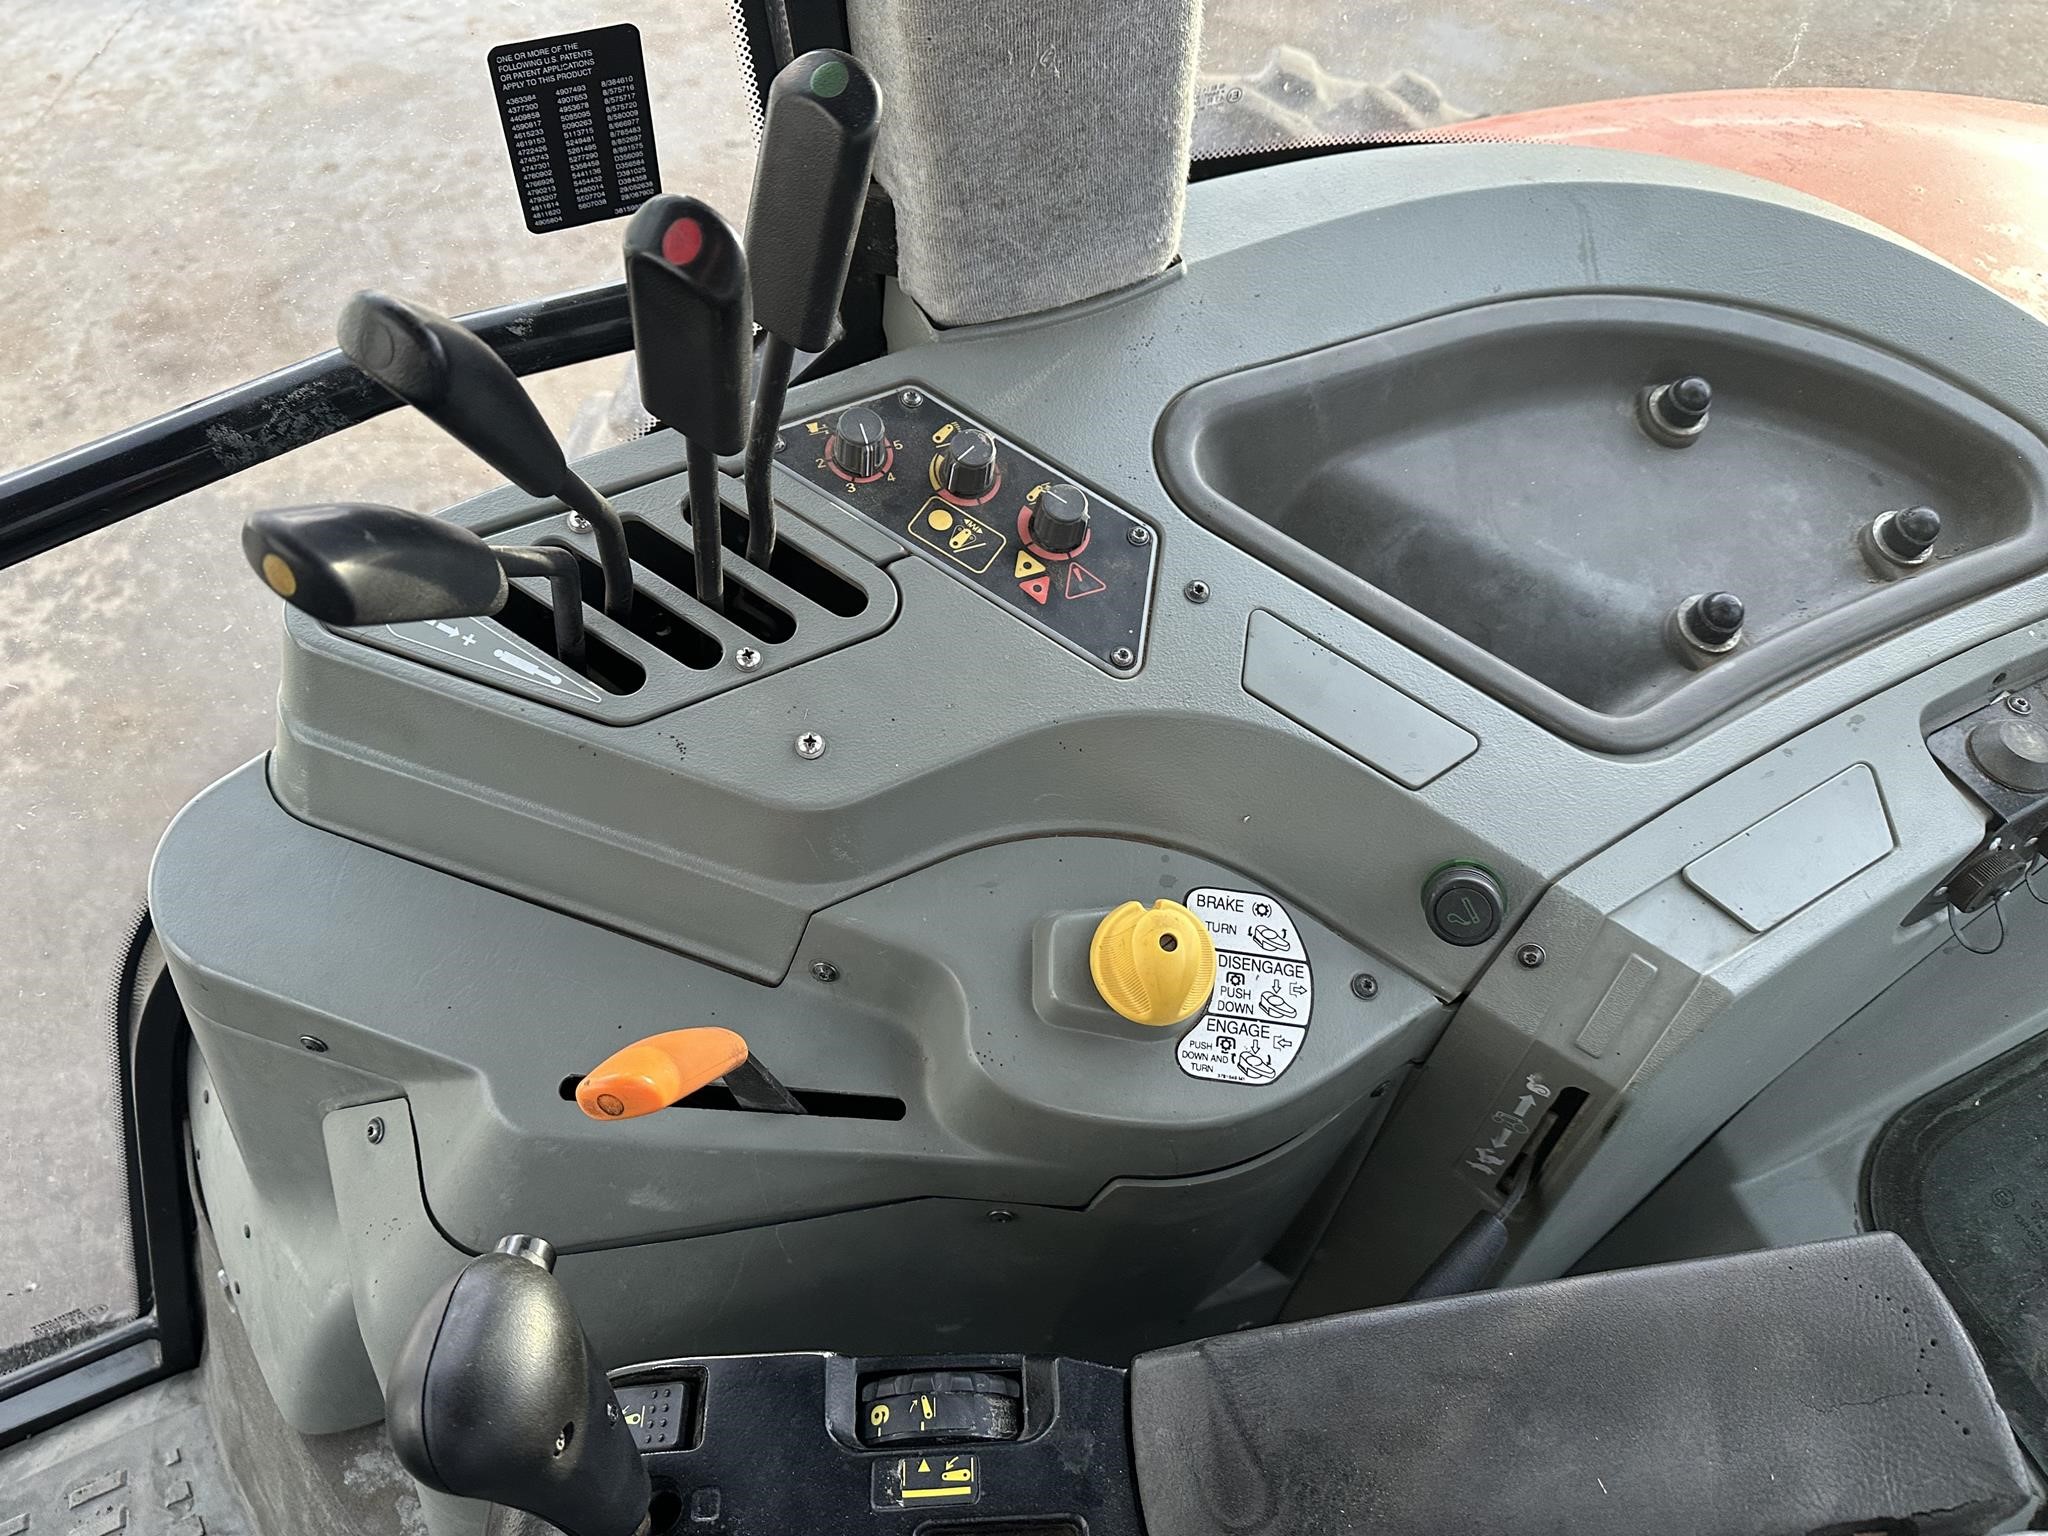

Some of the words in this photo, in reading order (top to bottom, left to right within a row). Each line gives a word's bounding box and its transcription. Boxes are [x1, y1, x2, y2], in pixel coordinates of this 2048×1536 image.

[497, 55, 513, 63] ONE
[527, 48, 549, 57] MORE
[498, 59, 542, 72] FOLLOWING
[544, 56, 556, 64] U.S.
[560, 50, 592, 61] PATENTS
[513, 68, 540, 79] PATENT
[543, 59, 595, 73] APPLICATIONS
[503, 81, 524, 90] APPLY
[557, 68, 591, 80] PRODUCT
[602, 76, 633, 87] 8/384610
[556, 85, 586, 95] 4907493
[558, 94, 587, 103] 4907653
[508, 103, 538, 113] 4377300
[514, 129, 544, 138] 4615233
[564, 128, 593, 138] 5113715
[516, 138, 545, 147] 4619153
[519, 145, 547, 155] 4722426
[520, 154, 549, 163] 4745743
[569, 152, 598, 162] 5277290
[522, 162, 549, 172] 4747301
[574, 176, 602, 186] 5454432
[530, 194, 556, 203] 4793207
[894, 440, 904, 450] 5
[816, 457, 827, 468] 2
[887, 472, 895, 482] 4
[845, 482, 856, 493] 3
[1197, 894, 1244, 913] BRAKE
[1205, 921, 1237, 935] TURN
[1218, 955, 1305, 978] DISENGAGE
[1220, 986, 1251, 1000] PUSH
[1217, 1000, 1254, 1015] DOWN
[1207, 1019, 1270, 1039] ENGAGE
[1189, 1041, 1213, 1050] PUSH
[1182, 1051, 1209, 1061] DOWN
[1211, 1053, 1229, 1063] AND
[1191, 1063, 1214, 1072] TURN
